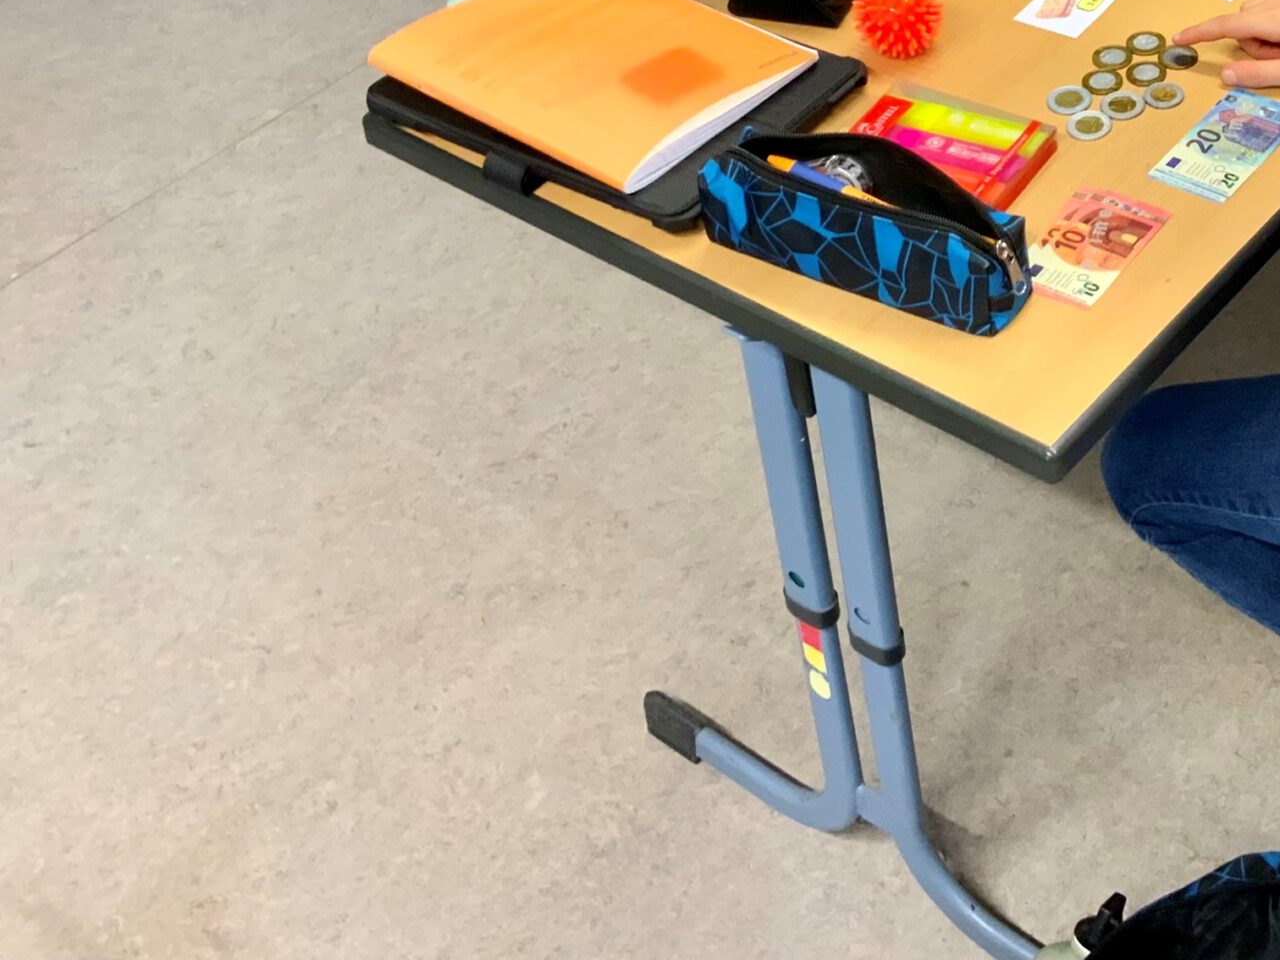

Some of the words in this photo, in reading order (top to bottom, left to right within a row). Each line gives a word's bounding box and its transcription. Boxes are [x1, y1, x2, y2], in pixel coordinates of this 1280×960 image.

[1186, 129, 1221, 154] 20
[1221, 172, 1240, 189] 20
[1054, 229, 1086, 250] 10
[1084, 280, 1100, 296] 10
